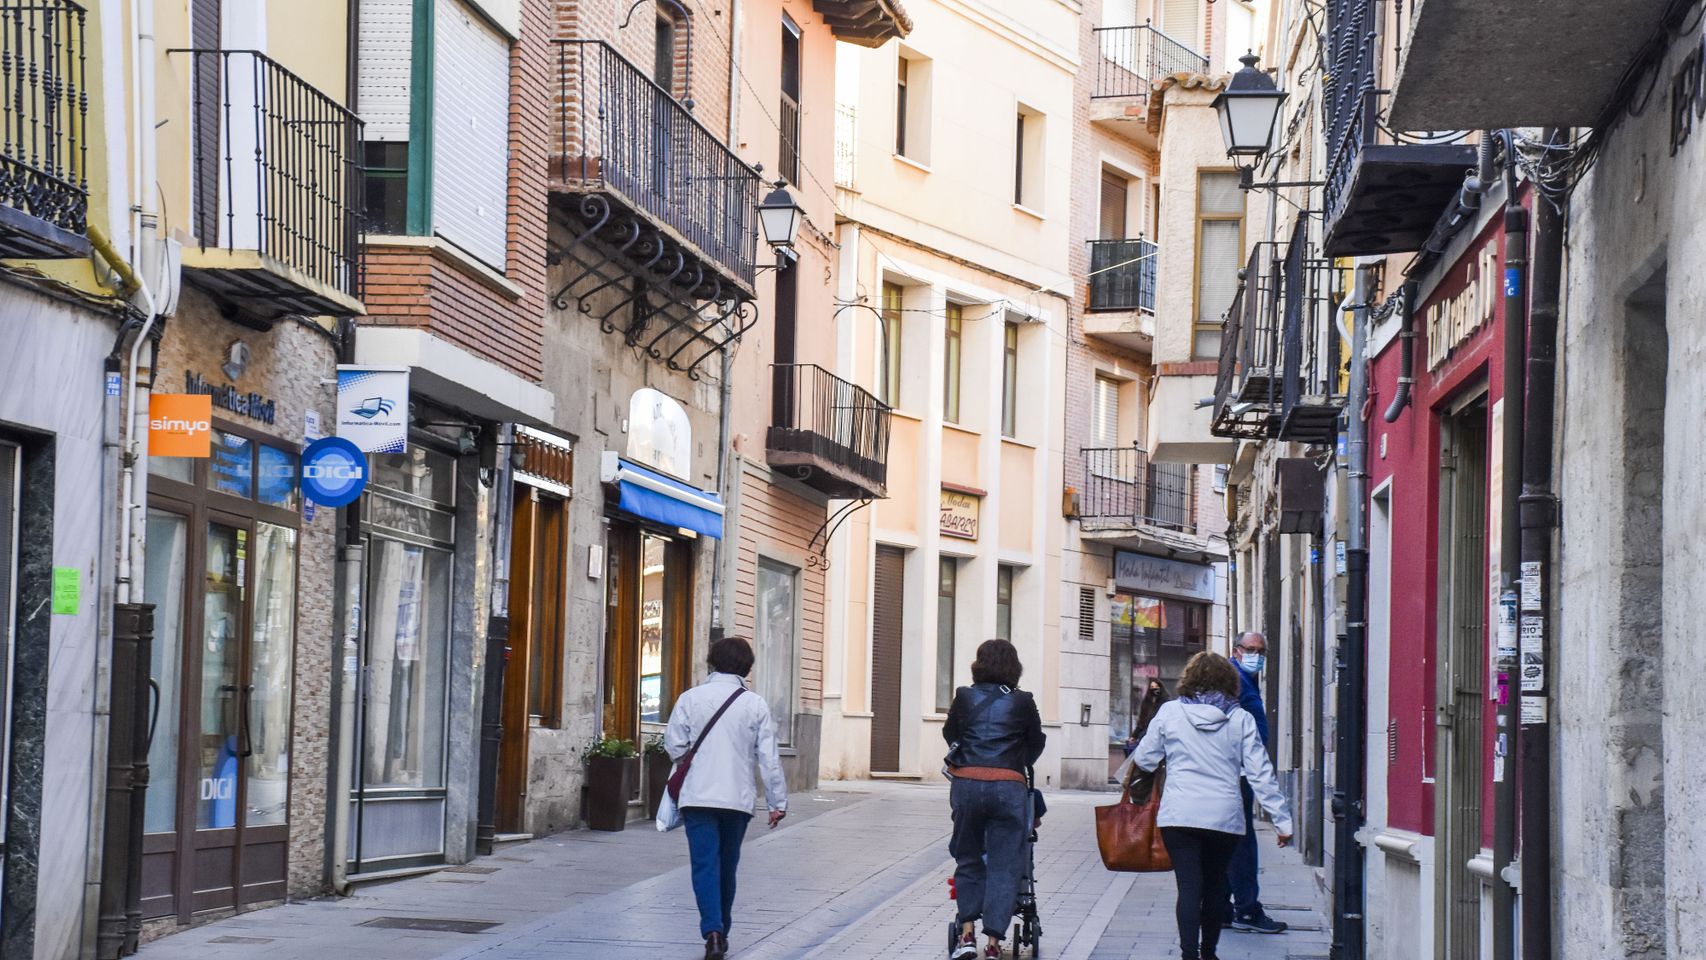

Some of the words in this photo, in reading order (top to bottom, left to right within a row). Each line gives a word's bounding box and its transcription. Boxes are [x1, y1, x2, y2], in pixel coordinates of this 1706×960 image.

[151, 416, 209, 435] simyo
[303, 466, 362, 479] DIGI
[201, 778, 232, 800] DIGI
